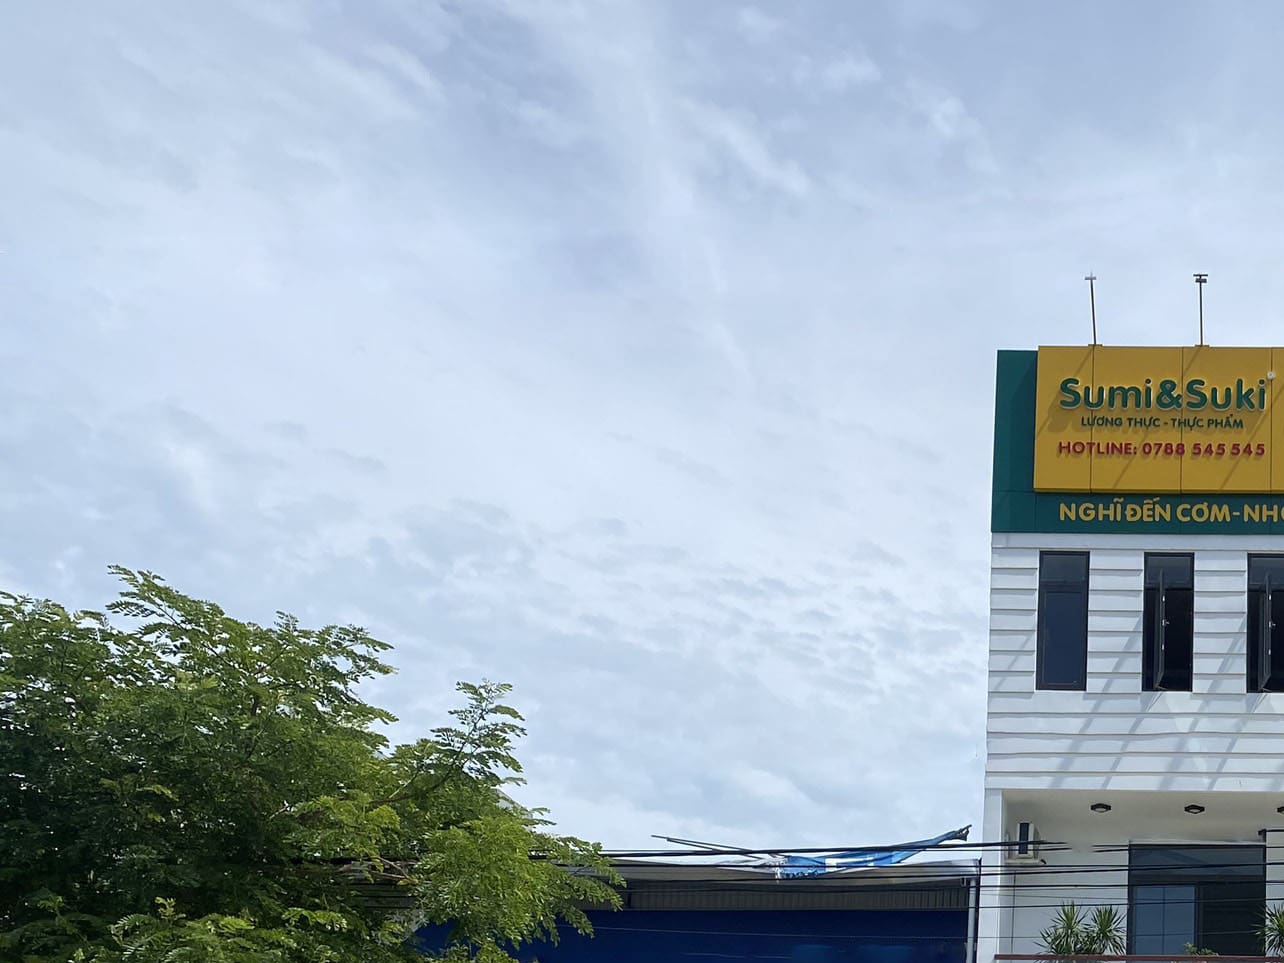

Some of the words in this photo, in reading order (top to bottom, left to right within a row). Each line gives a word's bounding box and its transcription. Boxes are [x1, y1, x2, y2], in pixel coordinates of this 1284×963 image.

[1059, 377, 1267, 410] Sumi&Suki
[1081, 415, 1123, 428] LƯƠNG
[1128, 416, 1161, 430] THỰC
[1171, 417, 1204, 431] THỰC
[1207, 414, 1244, 429] PHẨM
[1058, 441, 1137, 456] HOTLINE:
[1142, 442, 1186, 456] 0788
[1191, 442, 1226, 457] 545
[1230, 443, 1266, 457] 545
